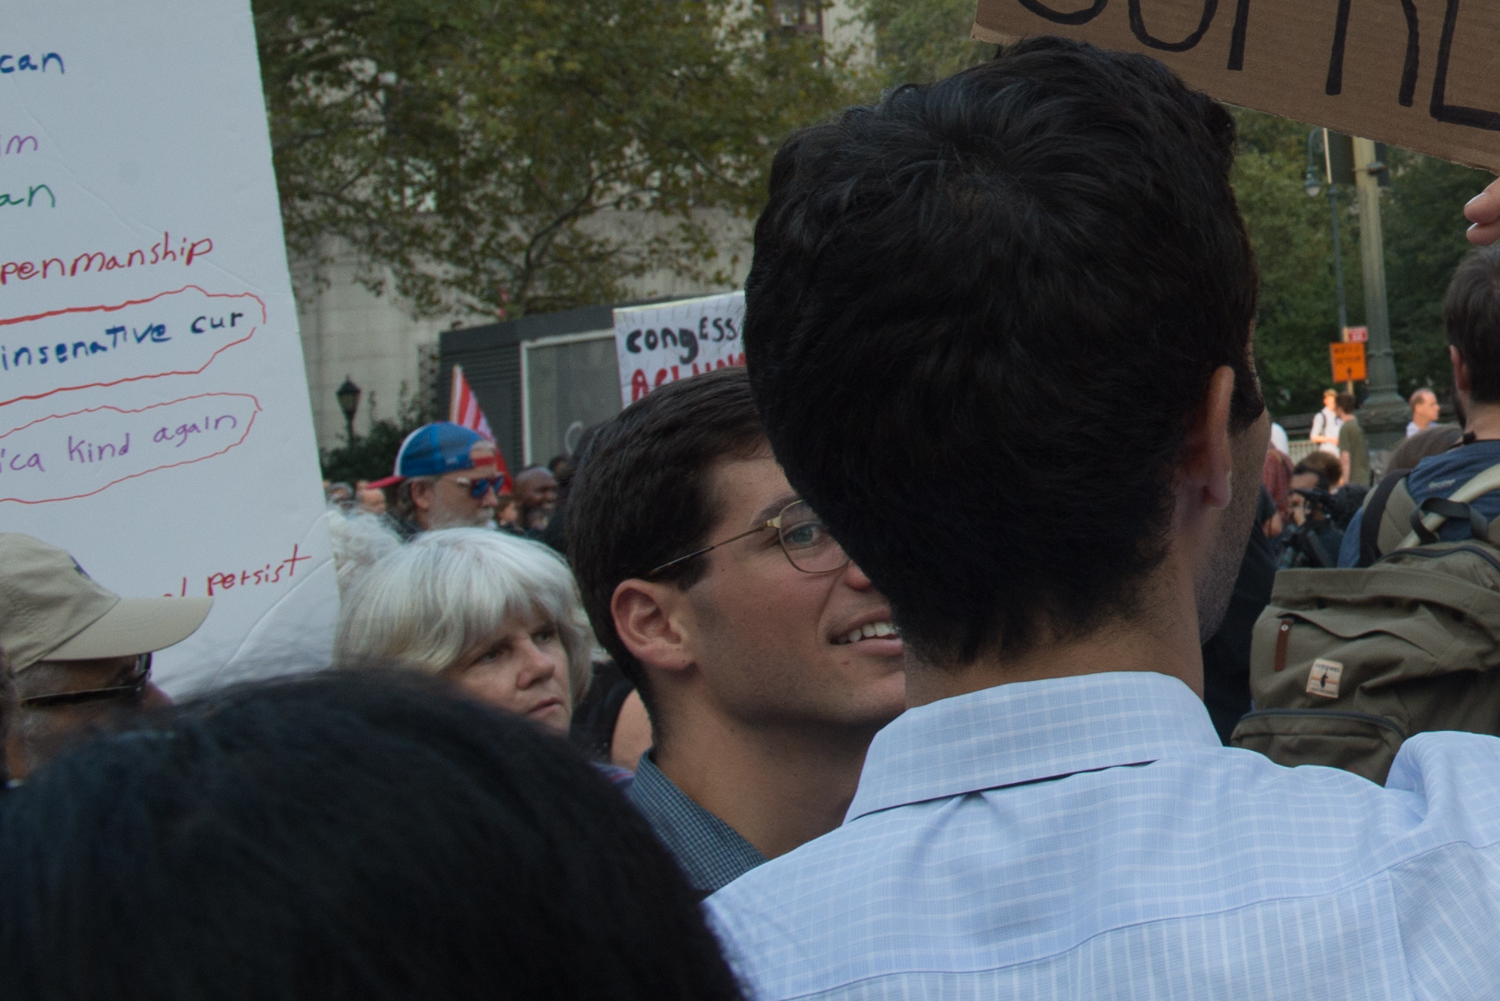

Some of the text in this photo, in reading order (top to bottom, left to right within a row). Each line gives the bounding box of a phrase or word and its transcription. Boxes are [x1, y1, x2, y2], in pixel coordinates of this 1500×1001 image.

[1, 231, 213, 285] penmanship
[191, 311, 243, 333] cur
[153, 415, 237, 447] again
[207, 544, 312, 596] persist
